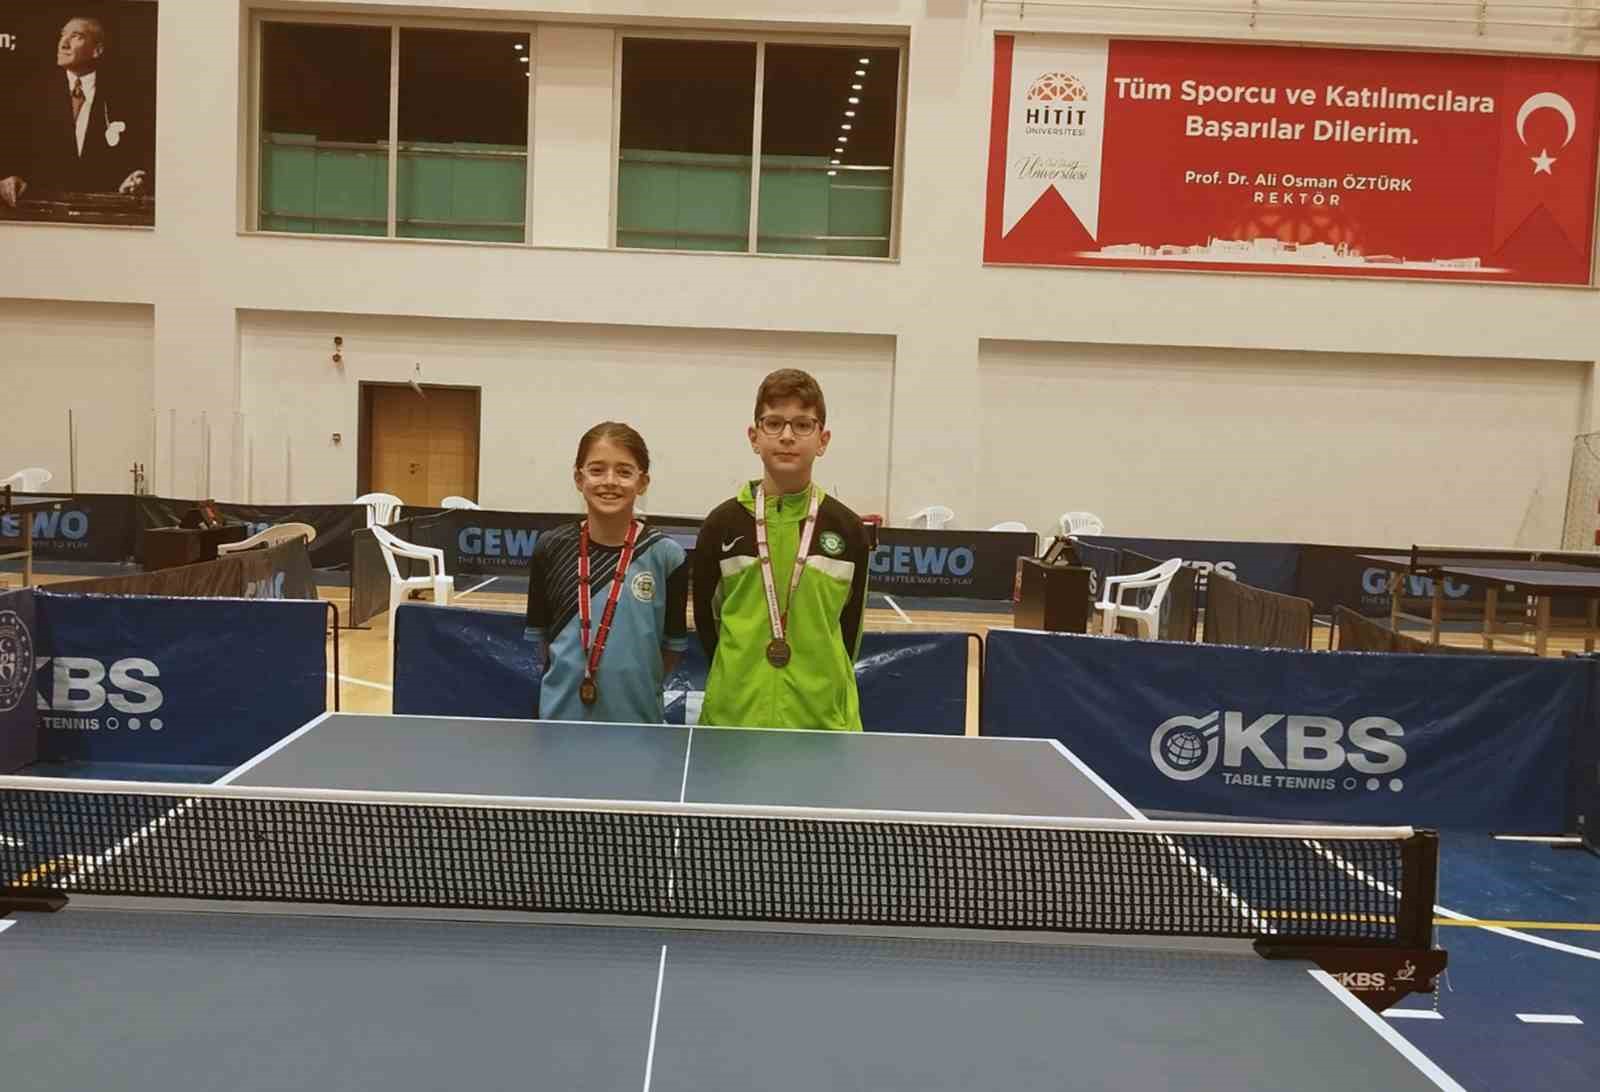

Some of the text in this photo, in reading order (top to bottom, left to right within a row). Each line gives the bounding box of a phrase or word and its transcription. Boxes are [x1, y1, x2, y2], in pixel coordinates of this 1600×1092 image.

[1114, 77, 1494, 113] Tüm Sporcu ve Katılımcılara
[1026, 105, 1087, 125] HİTİT
[1186, 115, 1419, 144] Başarılar Dilerim.
[1185, 170, 1412, 192] Prof. Dr. Ali Osman ÖZTÜRK
[1253, 191, 1341, 206] REKTÖR
[458, 527, 541, 557] GEW
[869, 544, 974, 576] GEWO
[42, 717, 99, 730] TENNIS
[1223, 711, 1407, 774] KBS
[1222, 772, 1336, 790] TABLE TENNIS
[1342, 972, 1385, 986] KBS
